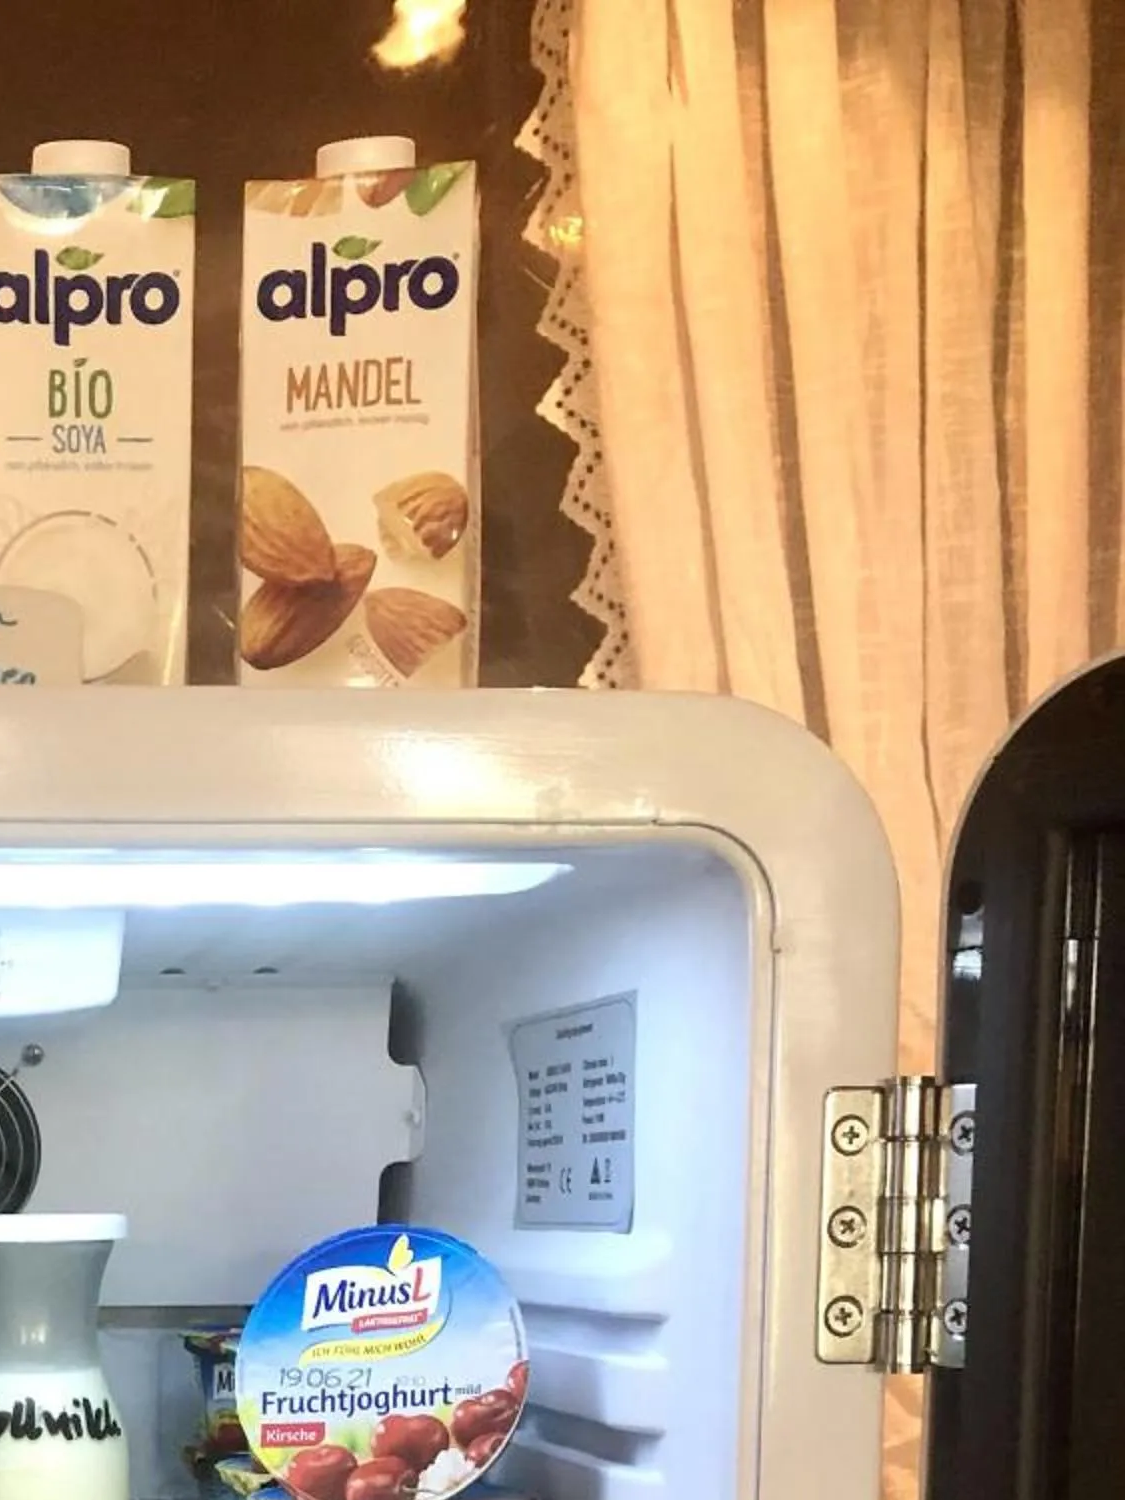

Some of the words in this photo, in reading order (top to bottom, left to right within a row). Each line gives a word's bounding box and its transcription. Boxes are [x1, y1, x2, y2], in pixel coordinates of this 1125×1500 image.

[256, 242, 459, 336] alpro
[286, 356, 421, 413] MANDEL
[52, 424, 106, 453] SOYA
[312, 1267, 431, 1319] MinusL
[262, 1382, 452, 1417] Fruchtjoghurt
[266, 1429, 316, 1442] Kirsche
